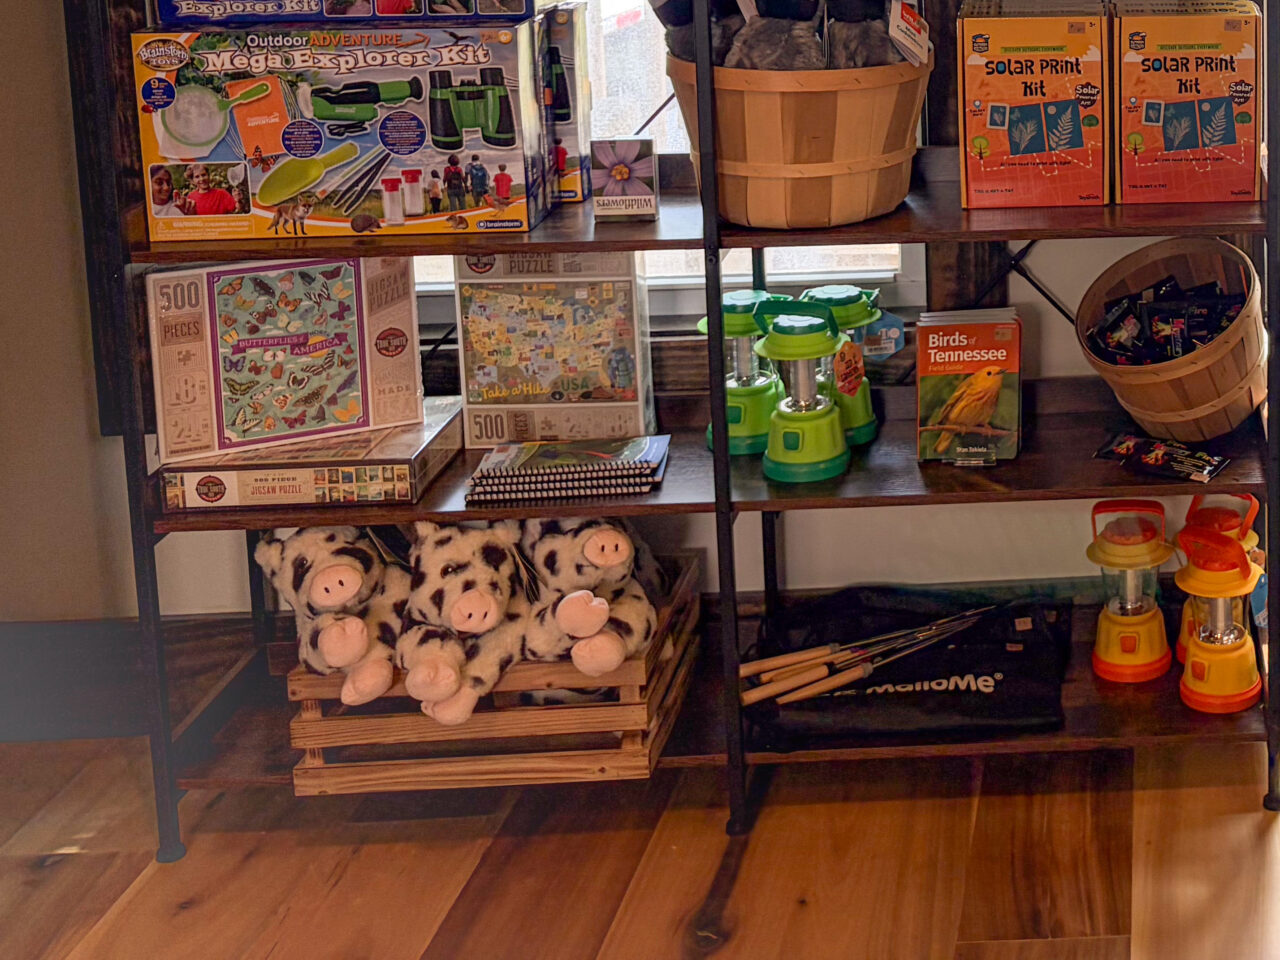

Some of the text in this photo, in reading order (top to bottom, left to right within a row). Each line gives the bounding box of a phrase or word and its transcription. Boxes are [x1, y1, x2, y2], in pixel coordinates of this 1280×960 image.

[178, 0, 279, 18] Explorer
[247, 32, 402, 47] Outdoor ADVENTURE
[139, 44, 190, 61] Brainstorm
[203, 45, 490, 74] Mega Explorer Kit
[1076, 85, 1100, 95] Solar
[1229, 83, 1252, 91] Solar
[486, 220, 521, 228] brainstorm
[510, 260, 553, 273] PUZZLE
[159, 281, 199, 312] 500
[370, 283, 408, 312] PUZZLE
[163, 321, 200, 339] PIECES
[239, 337, 297, 348] BUTTERFLIES
[293, 338, 340, 355] AMERICA
[928, 331, 968, 348] Birds
[928, 347, 1007, 363] Tennessee
[945, 364, 963, 372] Guide
[378, 384, 411, 395] MADE
[481, 383, 550, 399] Take Hike
[561, 379, 590, 392] USA
[474, 414, 505, 440] 500
[514, 413, 528, 439] PIECES
[250, 484, 302, 495] JIGSAW PUZZLE
